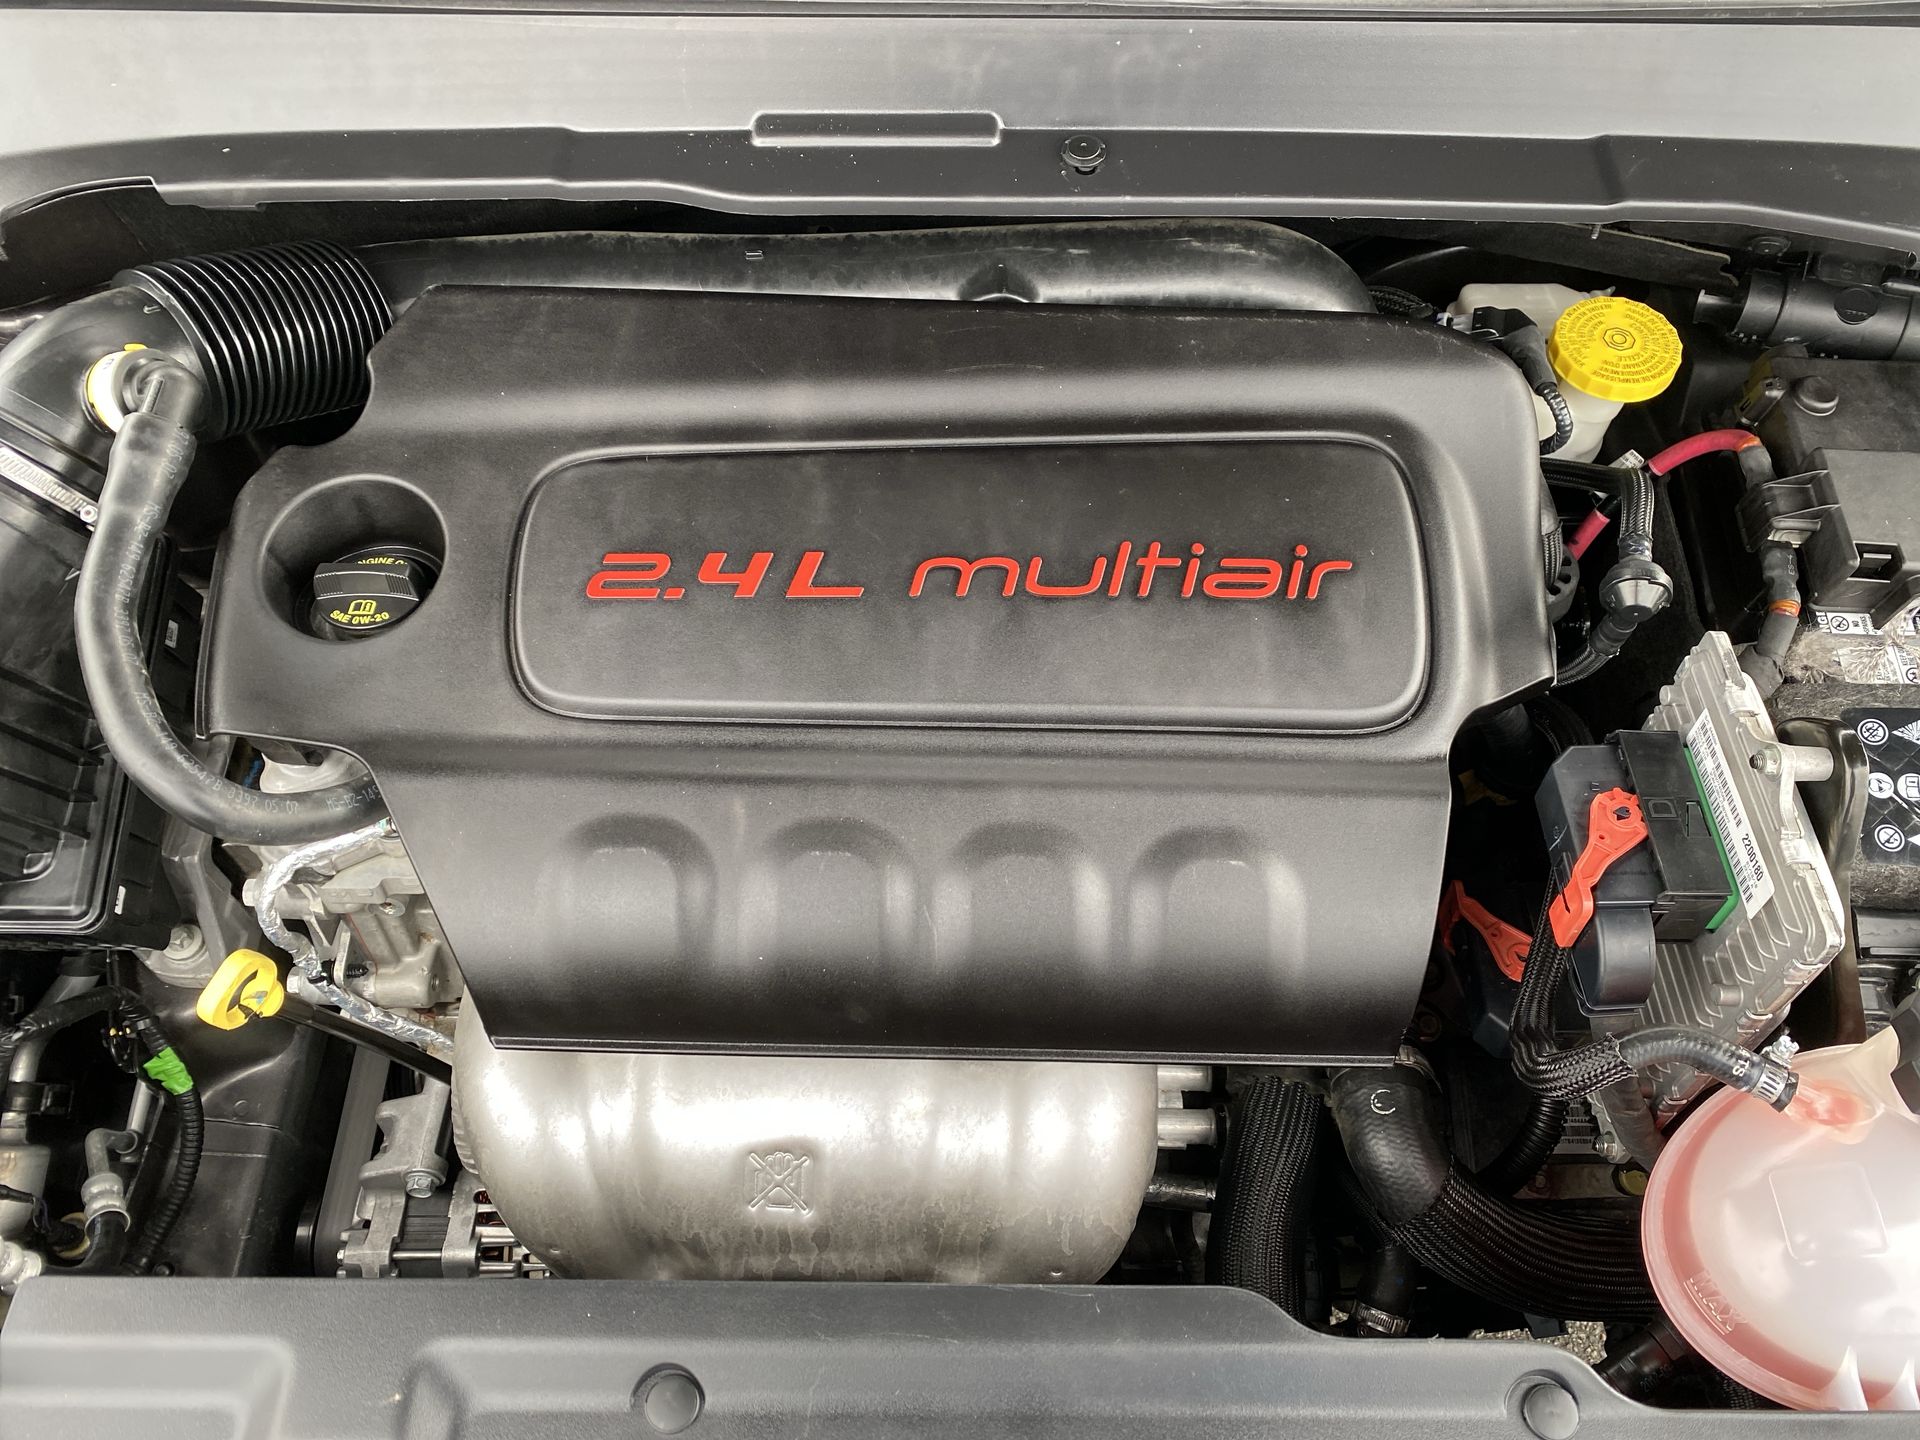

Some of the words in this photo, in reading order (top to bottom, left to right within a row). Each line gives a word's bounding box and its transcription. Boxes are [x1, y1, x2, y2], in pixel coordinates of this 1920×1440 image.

[908, 540, 1353, 599] multiair
[329, 609, 352, 624] SAE
[1741, 833, 1765, 882] 2200180
[1688, 1269, 1748, 1332] MAX
